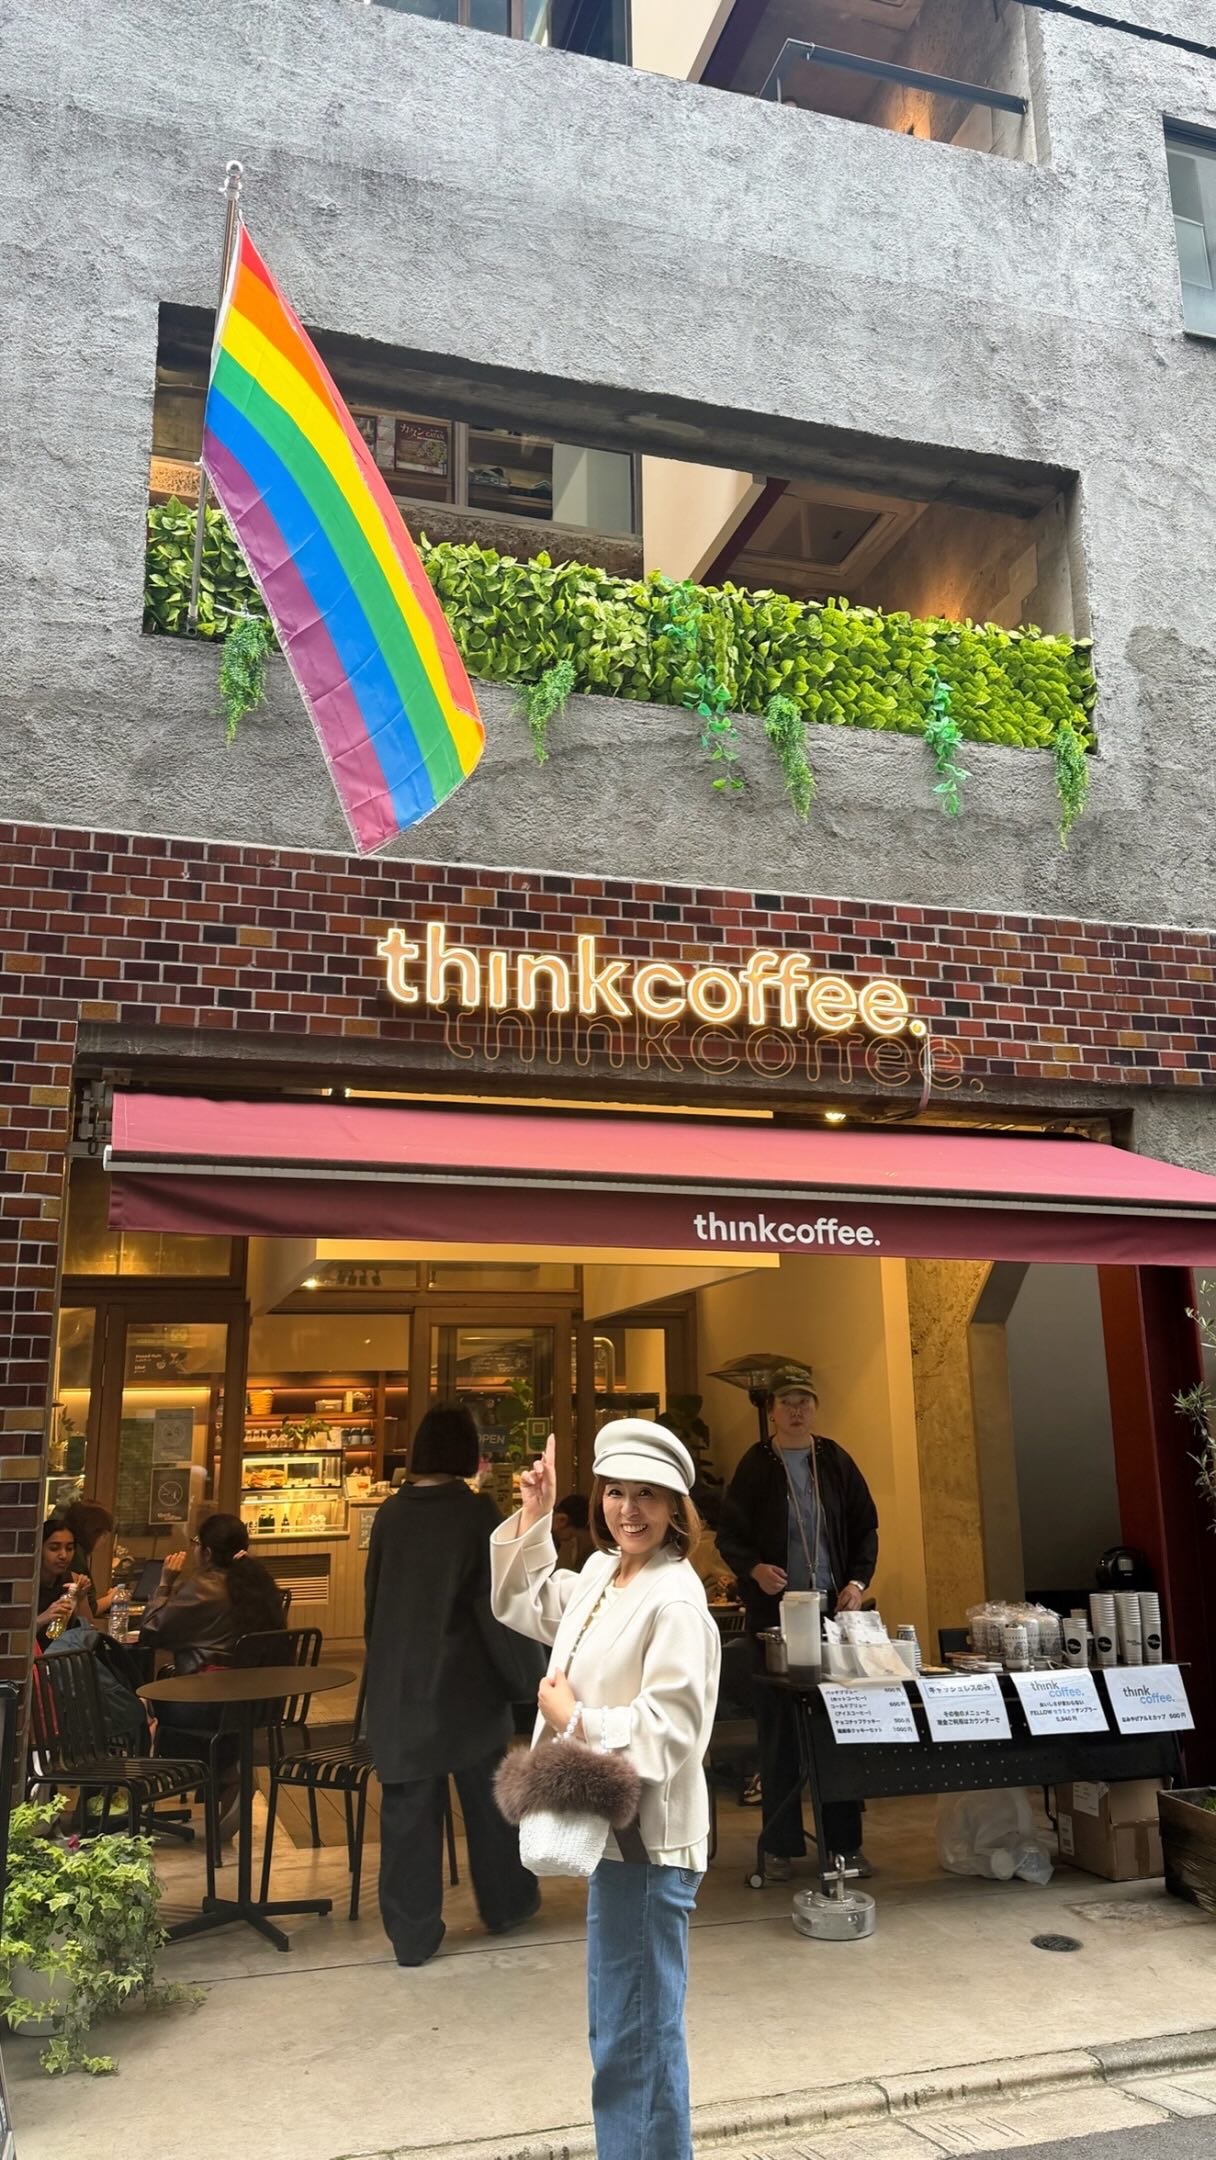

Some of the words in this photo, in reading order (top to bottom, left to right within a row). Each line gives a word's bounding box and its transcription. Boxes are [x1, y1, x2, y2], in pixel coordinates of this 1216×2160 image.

[377, 922, 928, 1036] thinkcoffee.
[693, 1211, 881, 1246] thinkcoffee.
[928, 1684, 991, 1693] キャッシュレスのみ
[1031, 1680, 1060, 1691] think
[1123, 1685, 1151, 1697] think
[1049, 1686, 1085, 1698] coffee.
[1140, 1692, 1176, 1704] coffee.
